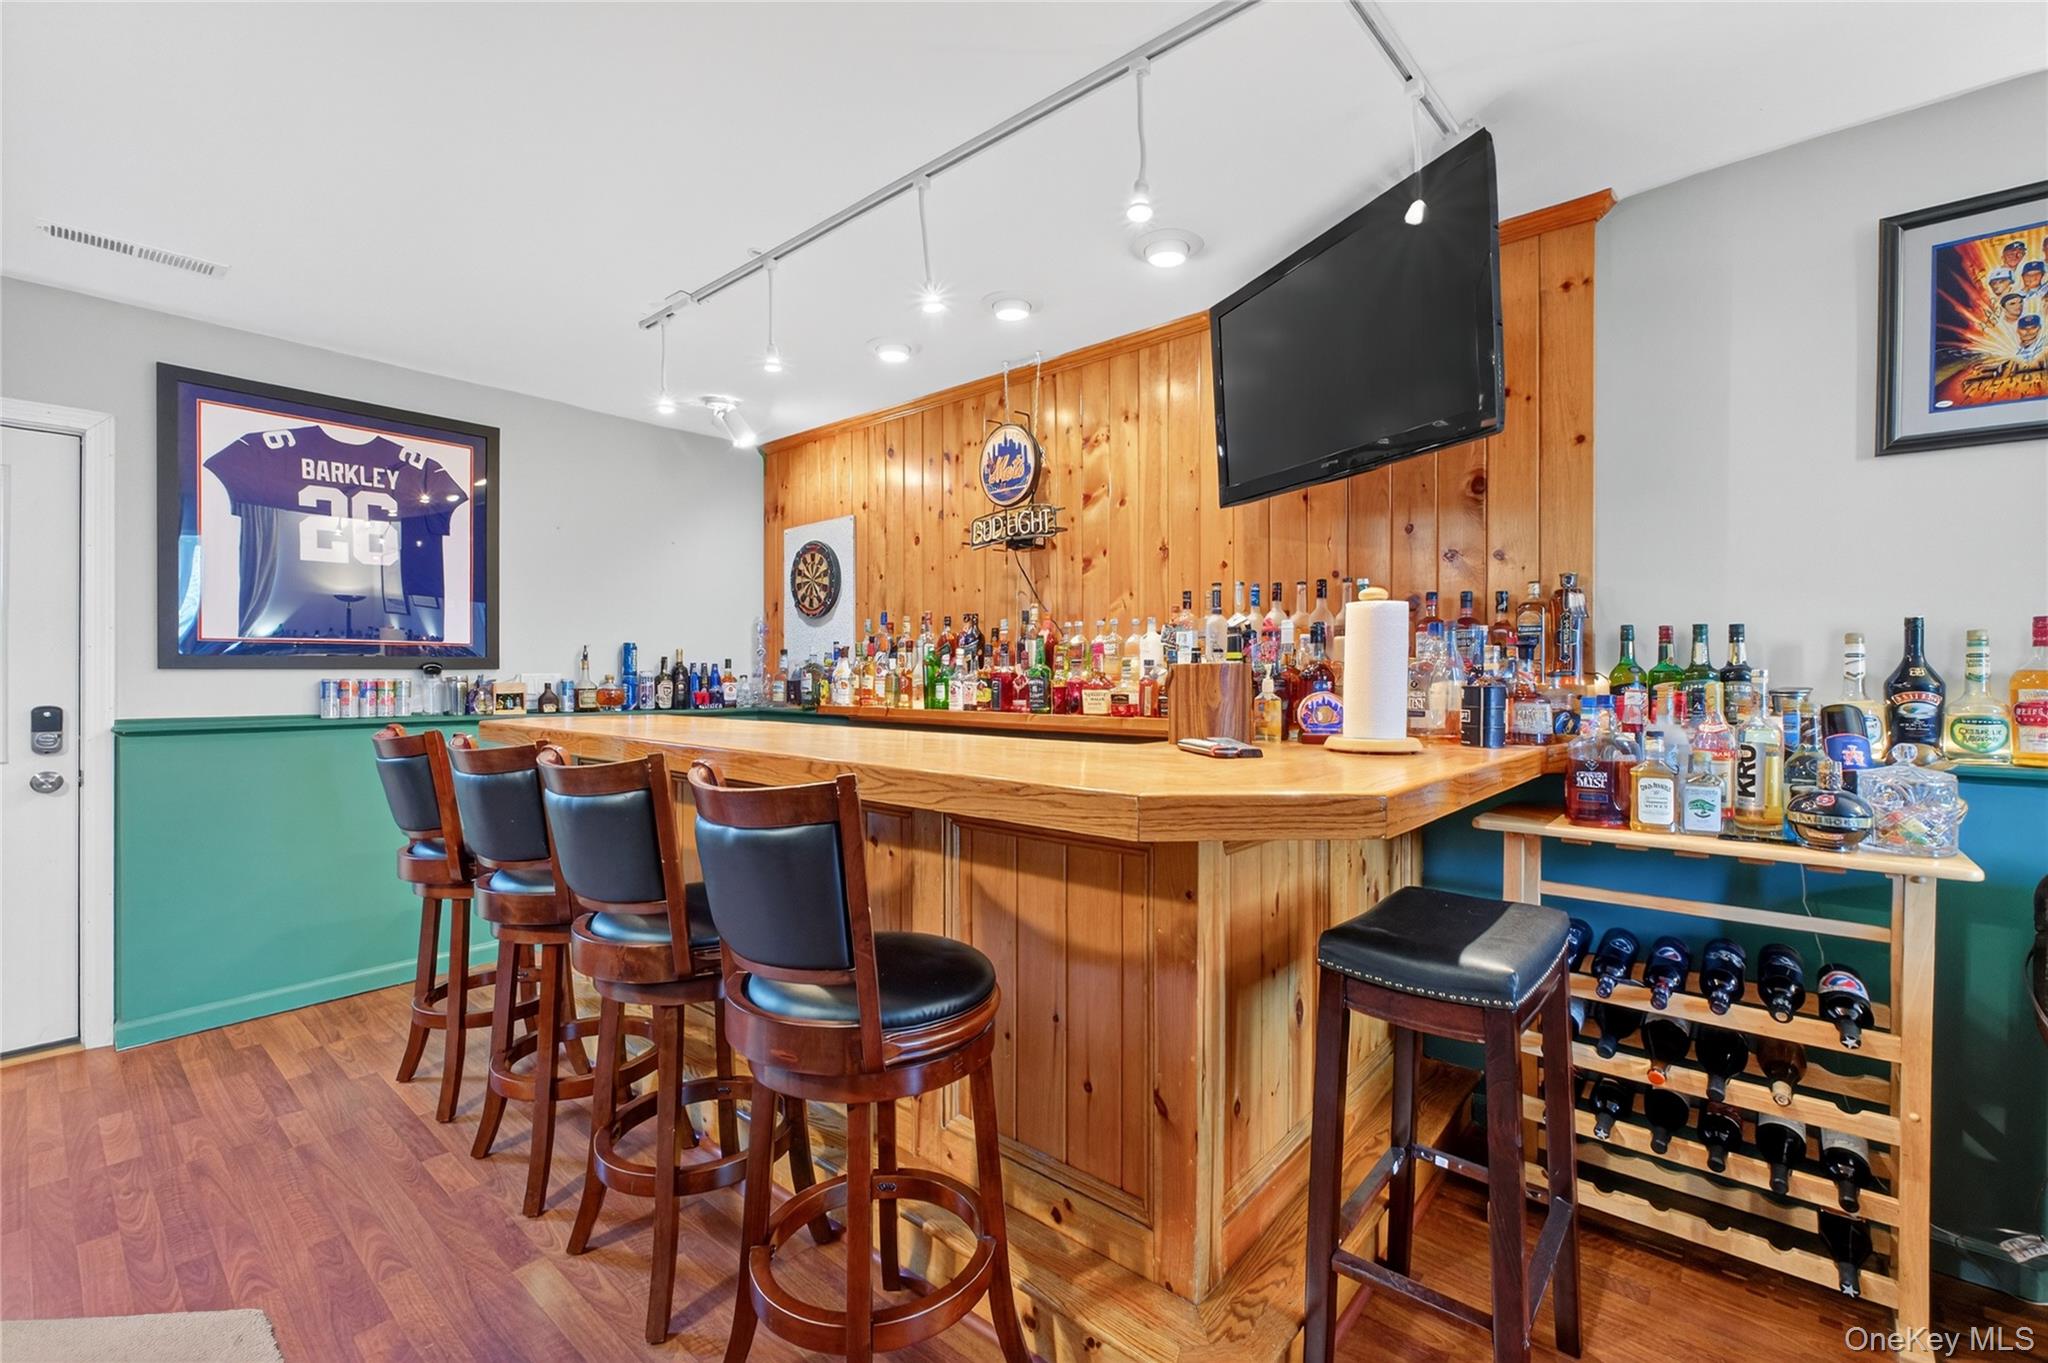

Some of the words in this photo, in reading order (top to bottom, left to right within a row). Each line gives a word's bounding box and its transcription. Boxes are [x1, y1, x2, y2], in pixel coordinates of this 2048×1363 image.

[301, 457, 400, 490] BARKLEY
[298, 484, 399, 567] 26
[972, 515, 1003, 545] BUD
[1737, 743, 1757, 798] KRU
